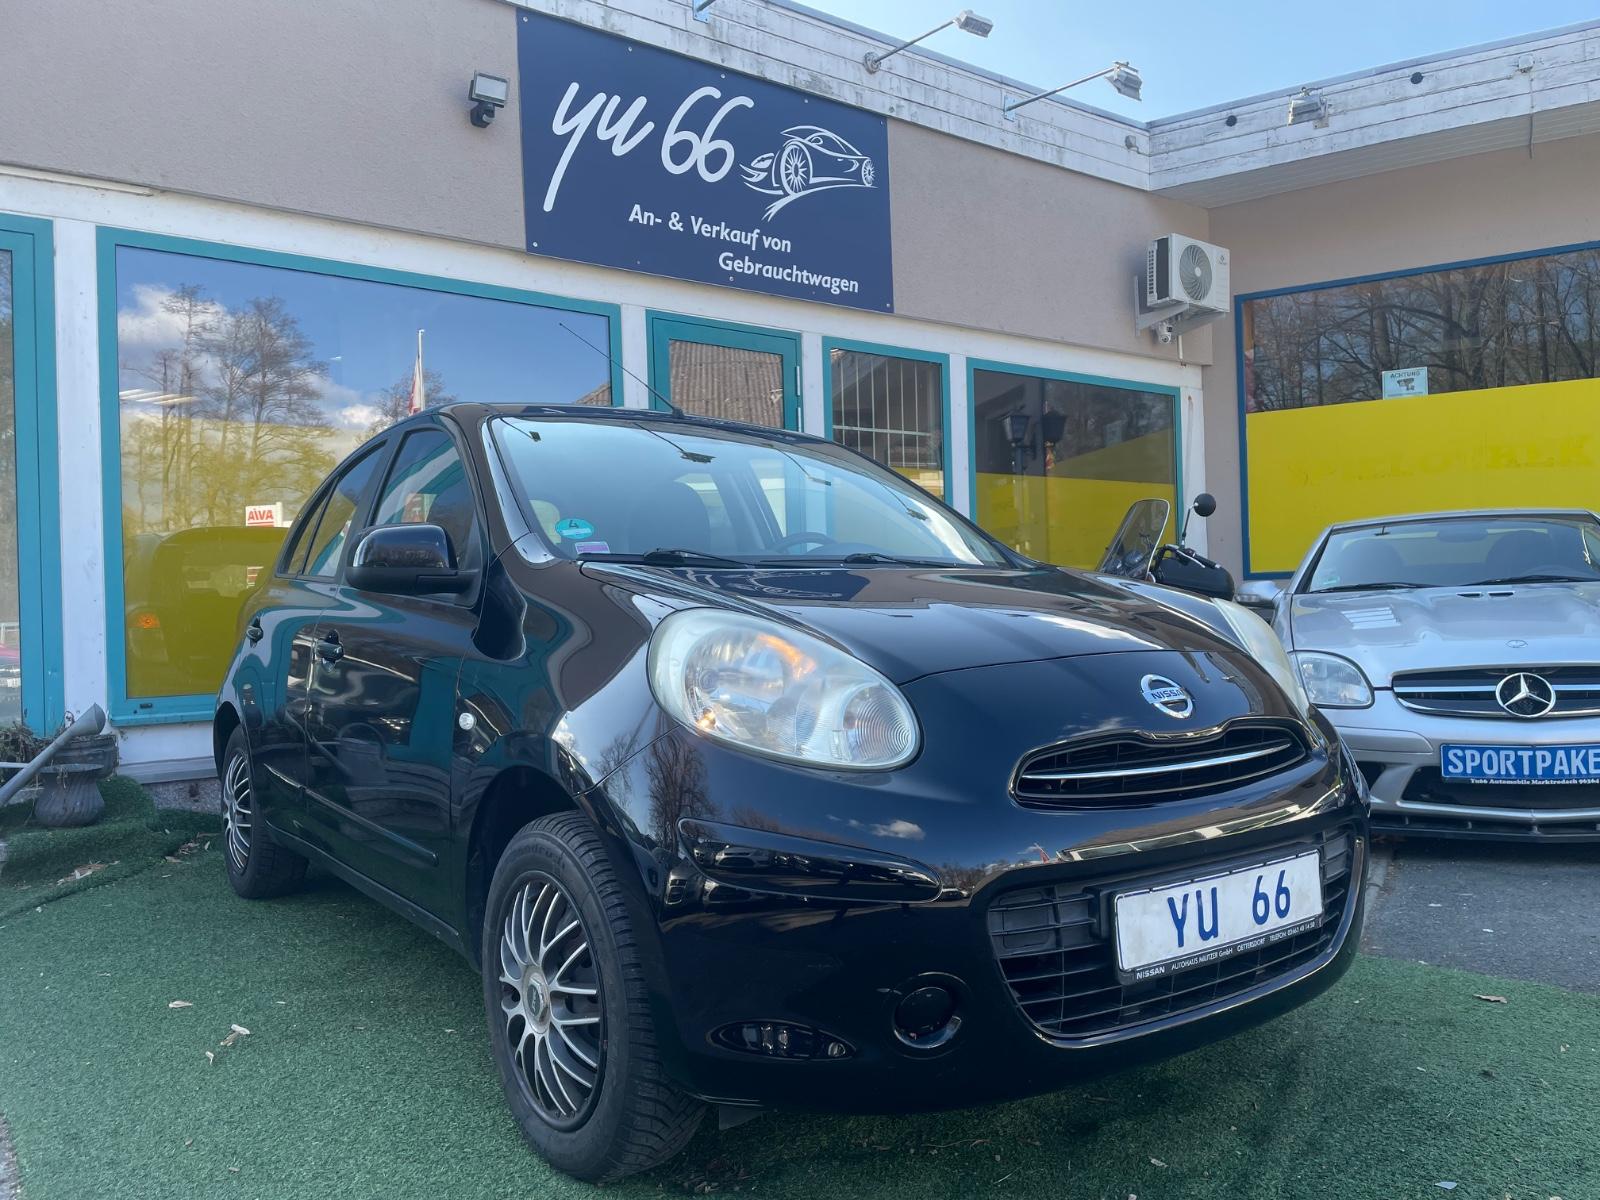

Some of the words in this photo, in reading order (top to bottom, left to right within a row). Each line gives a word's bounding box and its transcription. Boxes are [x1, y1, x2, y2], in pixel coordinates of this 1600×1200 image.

[661, 86, 754, 182] 66
[629, 204, 662, 226] An-
[668, 211, 684, 232] &
[690, 215, 760, 252] Verkauf
[762, 234, 791, 253] von
[718, 252, 859, 295] Gebrauchtwagen
[1390, 370, 1421, 378] ACHTUNG
[1151, 689, 1185, 700] NISSA
[1167, 886, 1219, 948] YU
[1251, 869, 1291, 926] 66
[1136, 966, 1166, 980] NISSAN
[1171, 957, 1199, 971] AUTOHAUS
[1218, 947, 1233, 957] GmbH
